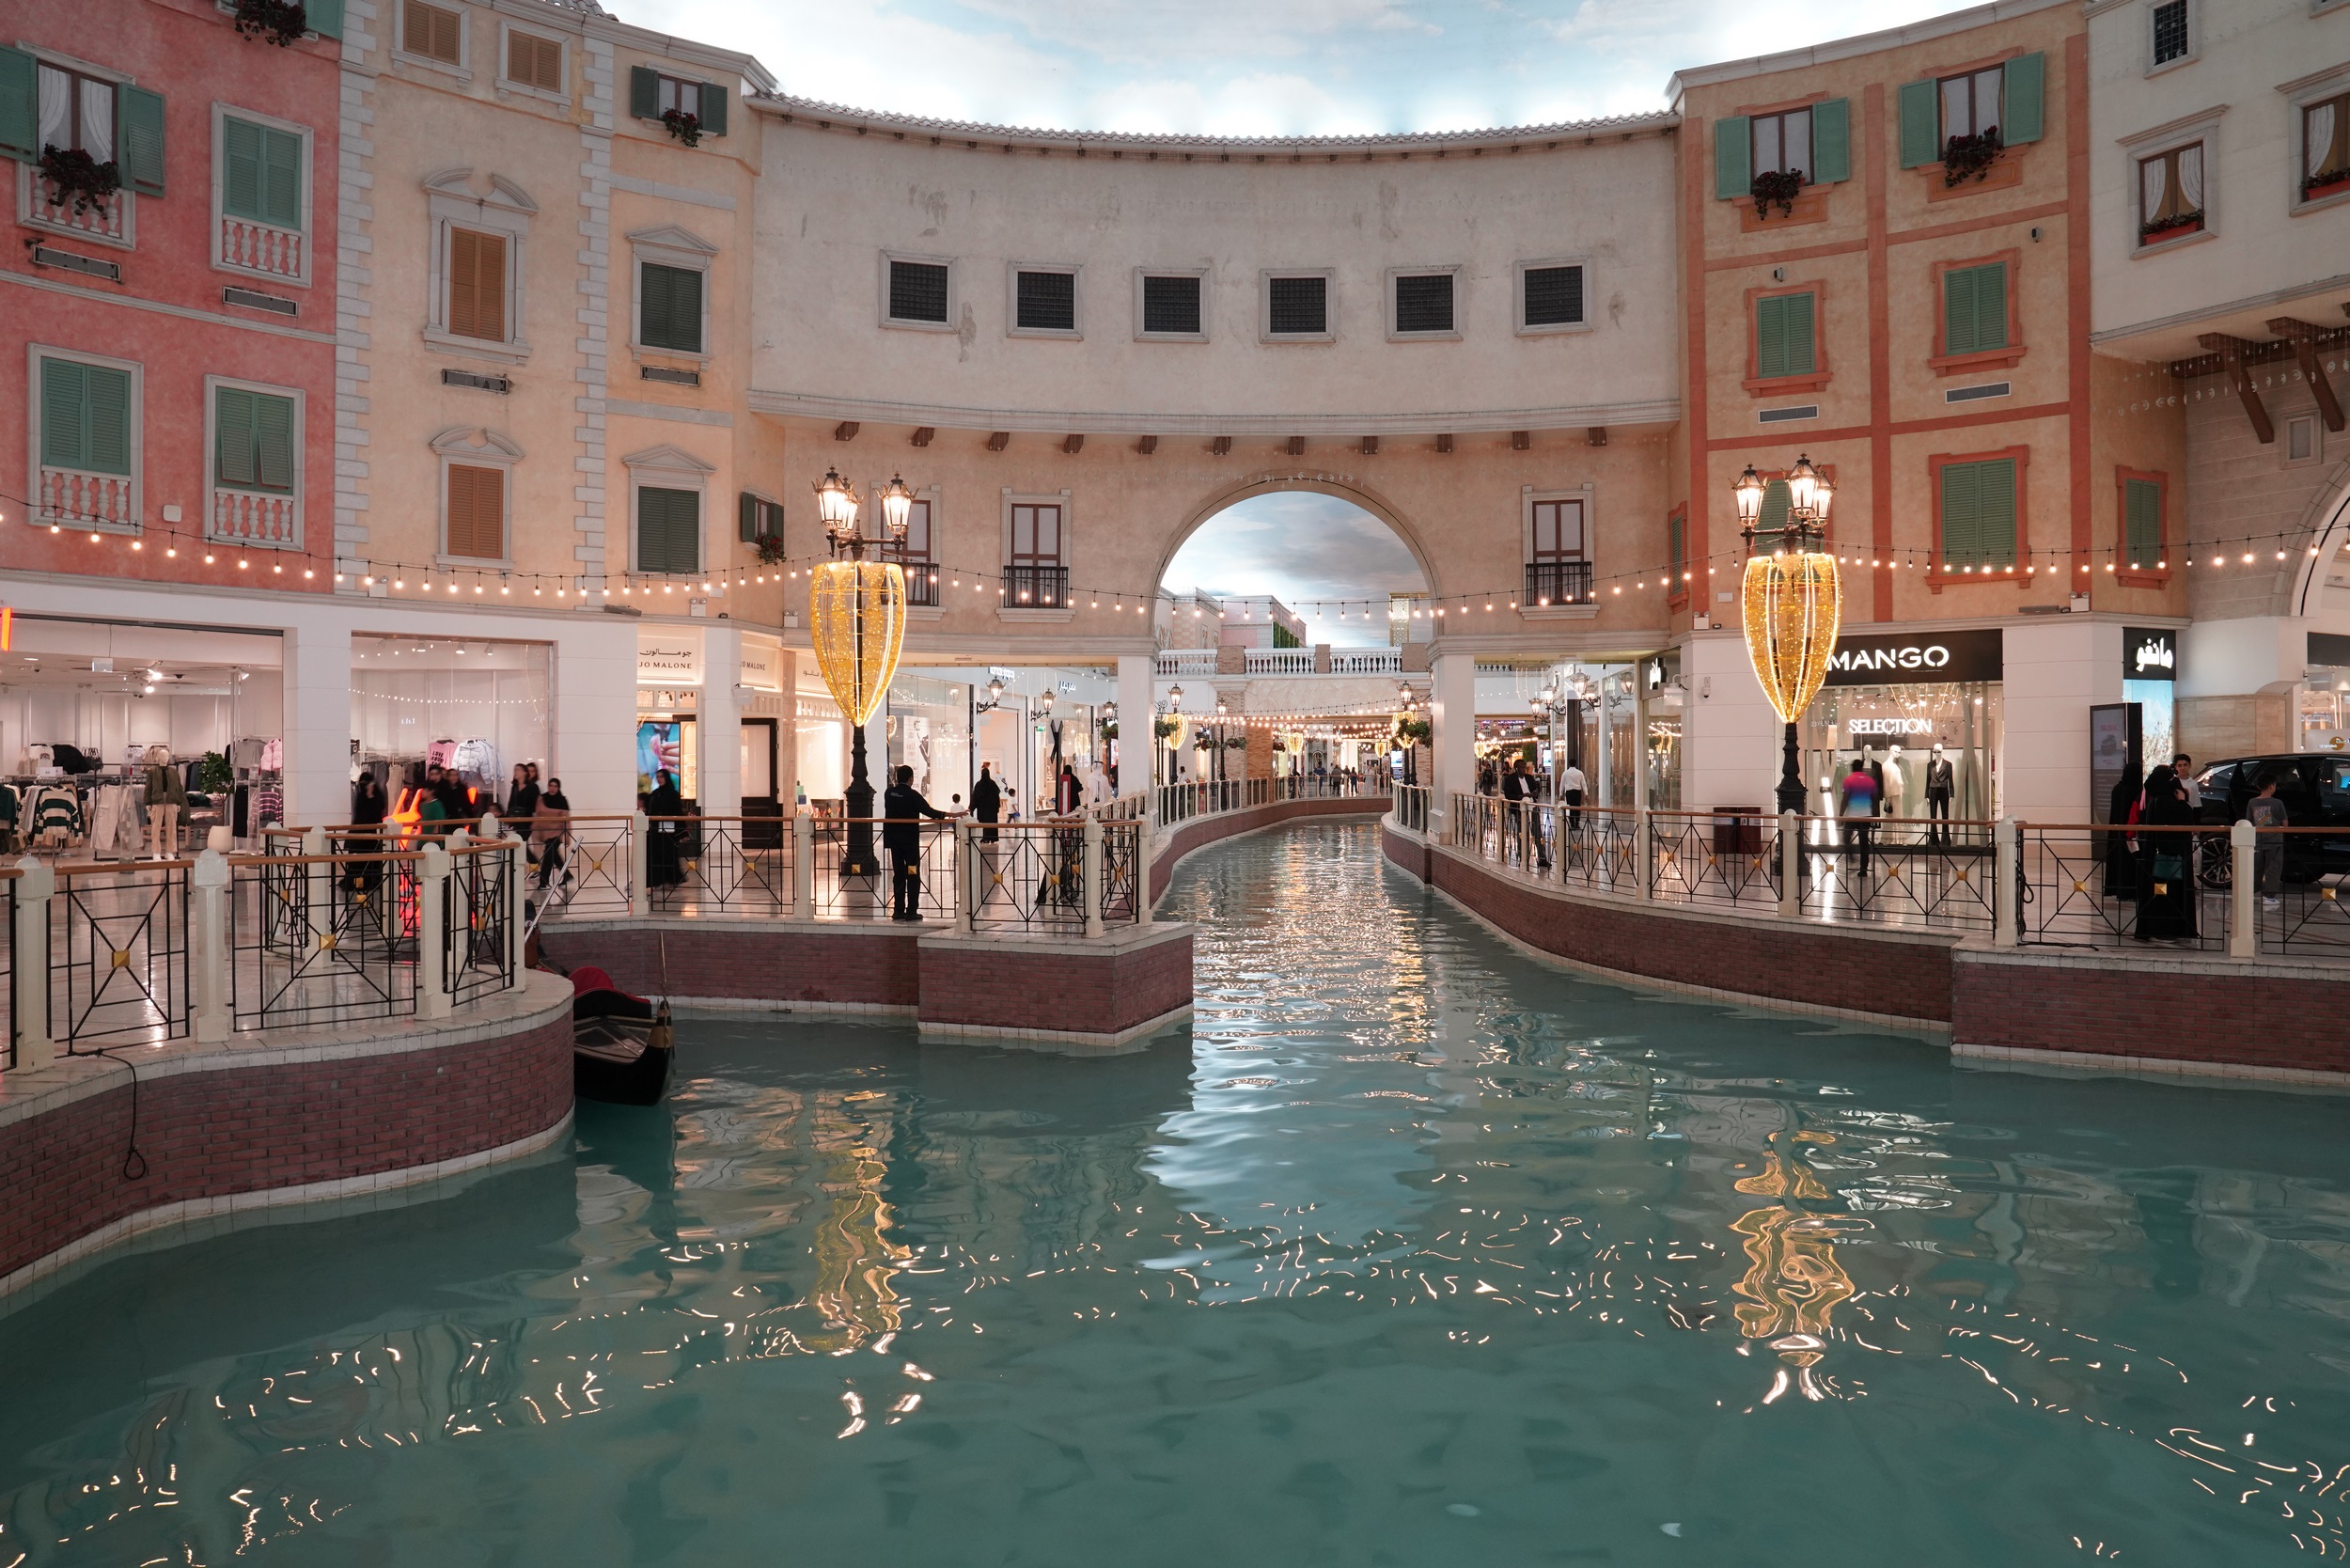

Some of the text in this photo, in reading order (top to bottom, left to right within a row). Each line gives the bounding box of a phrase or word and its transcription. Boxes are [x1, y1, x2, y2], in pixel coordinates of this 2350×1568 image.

[638, 648, 682, 657] مالون
[1827, 646, 1950, 671] MANGO
[2136, 637, 2173, 672] مانغو
[746, 661, 766, 671] MALONE
[1848, 718, 1933, 735] SELECTION
